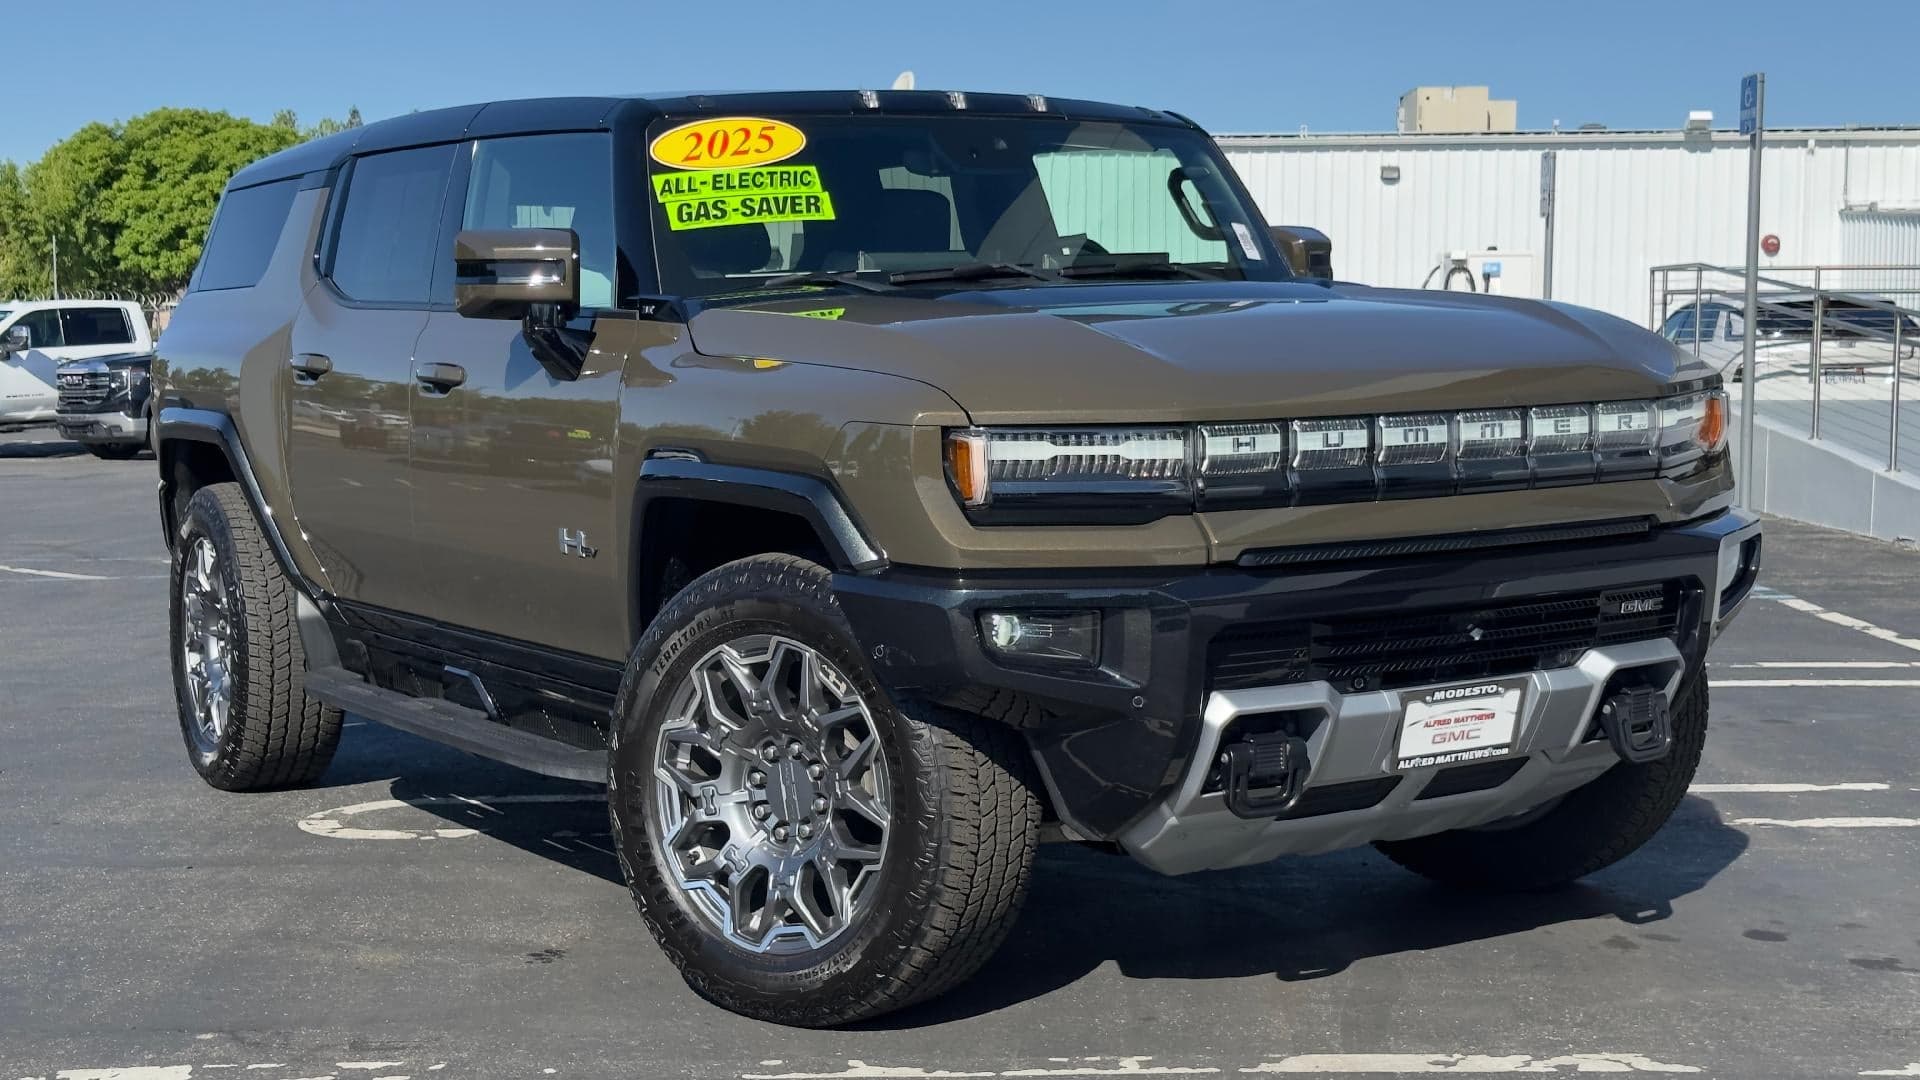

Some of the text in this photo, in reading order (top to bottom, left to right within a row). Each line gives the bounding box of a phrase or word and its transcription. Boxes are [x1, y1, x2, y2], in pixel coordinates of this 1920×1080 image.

[681, 126, 776, 162] 2025
[659, 170, 813, 197] ALL-ELECTRIC
[676, 195, 822, 224] GAS-SAVER
[1620, 597, 1664, 614] GMC
[654, 616, 712, 676] TERRITORY
[1432, 684, 1498, 701] MODESTO
[1423, 718, 1452, 729] ALFRED
[1453, 712, 1496, 724] MATTHEWS
[1431, 728, 1481, 745] GMC
